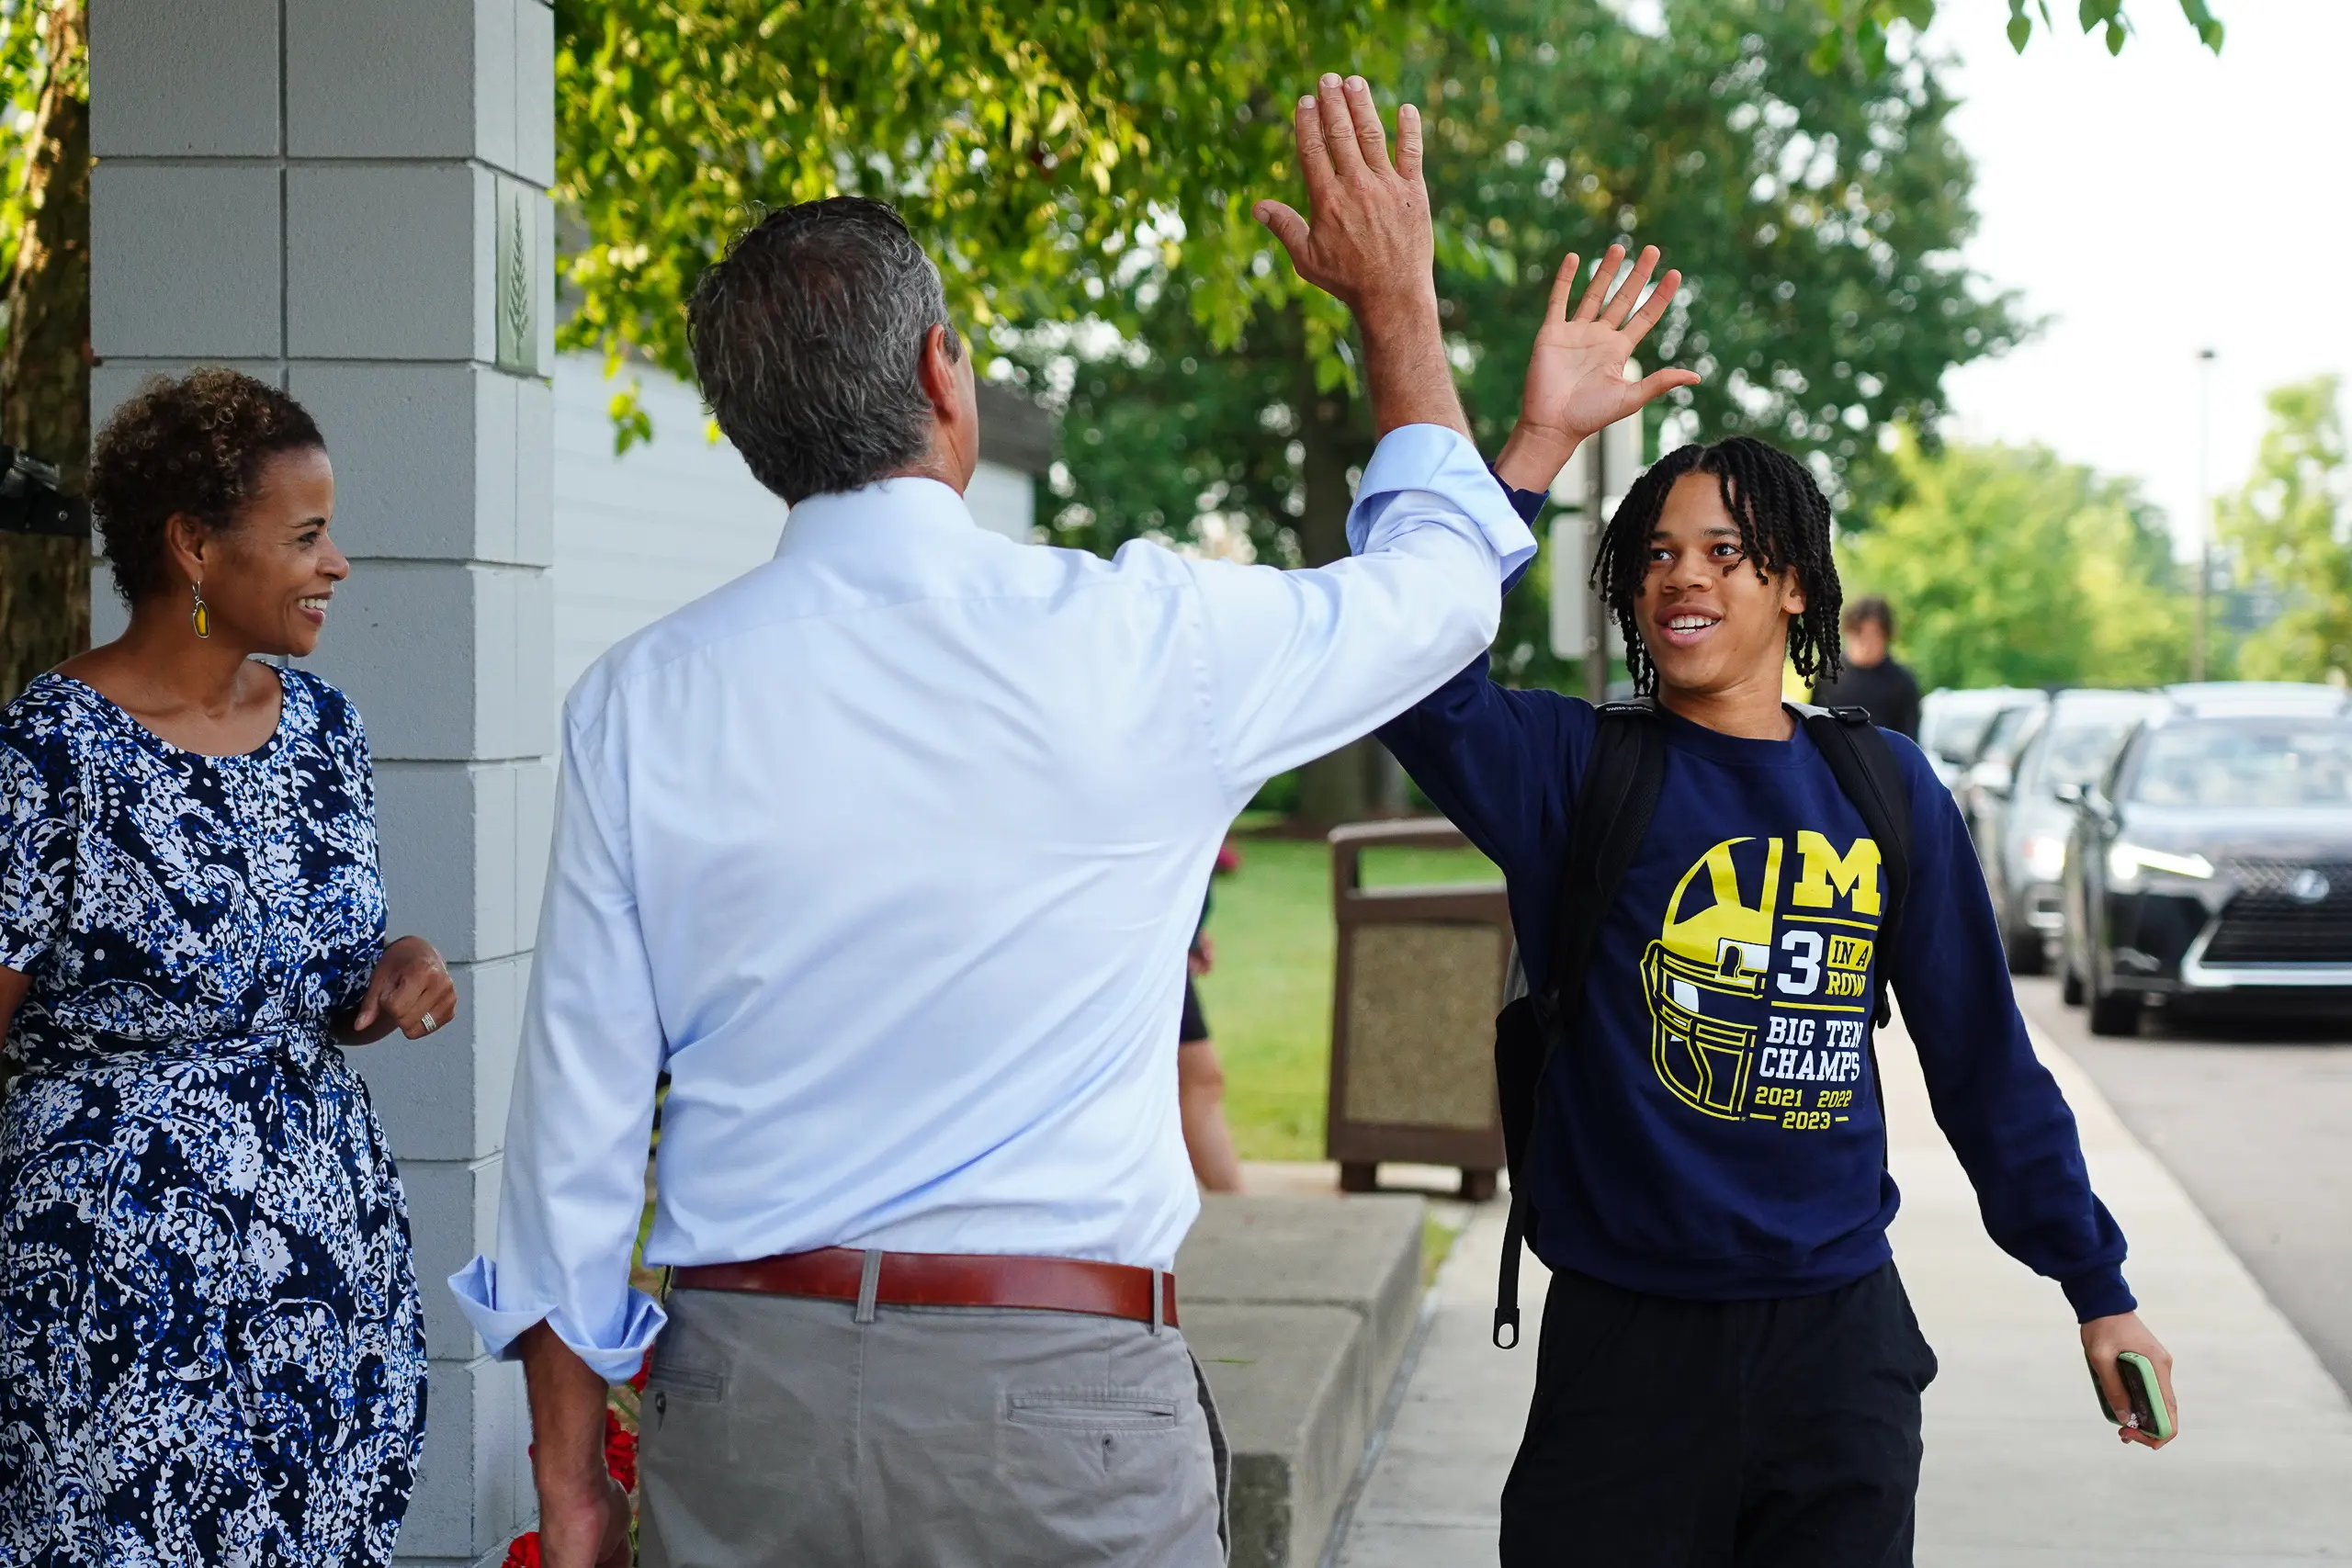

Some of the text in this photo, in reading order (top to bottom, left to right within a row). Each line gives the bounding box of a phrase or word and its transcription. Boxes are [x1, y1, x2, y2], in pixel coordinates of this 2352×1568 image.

[1792, 829, 1881, 915] M
[1777, 931, 1824, 995] 3
[1832, 940, 1869, 966] IN A
[1826, 971, 1866, 997] ROW
[1766, 1016, 1863, 1048] BIG TEN
[1758, 1047, 1860, 1081] CHAMPS
[1755, 1086, 1852, 1109] 2021 2022
[1782, 1111, 1831, 1130] 2023
